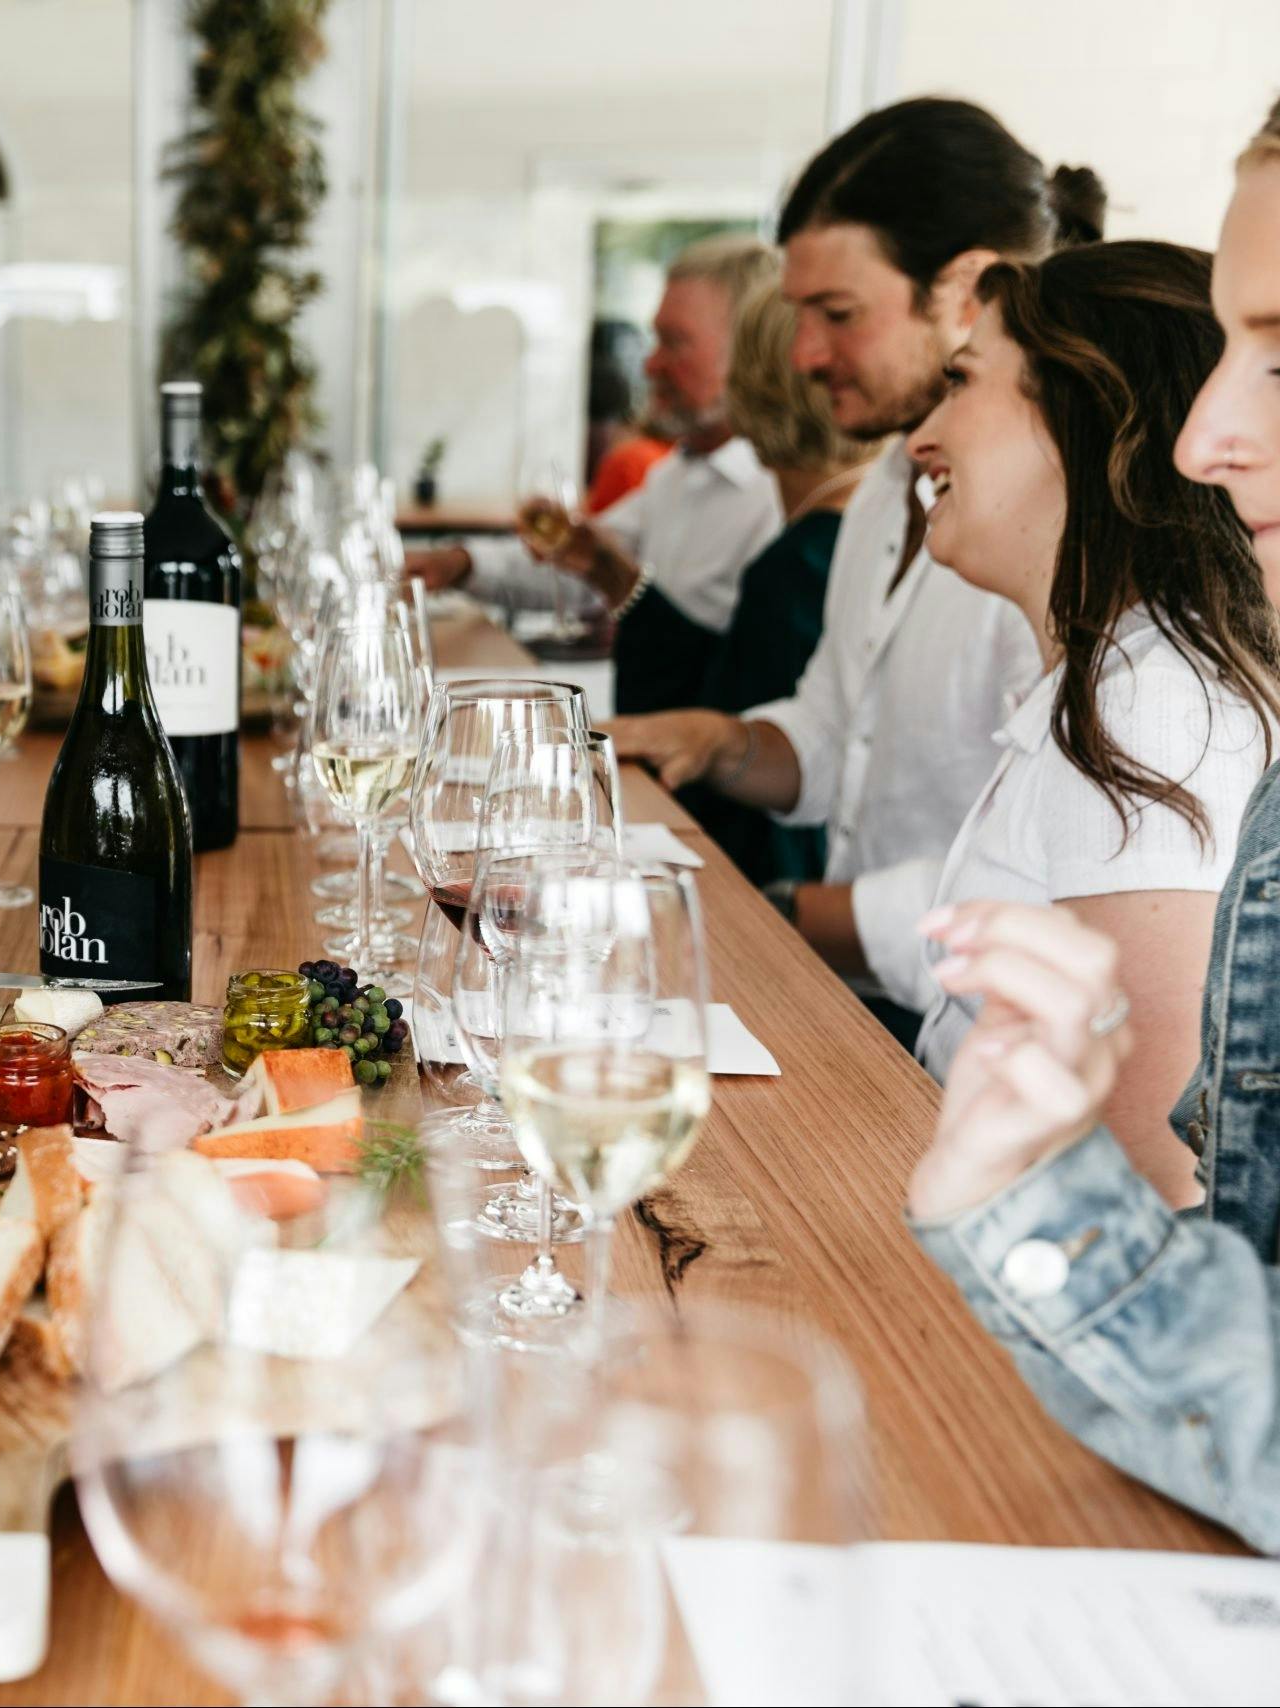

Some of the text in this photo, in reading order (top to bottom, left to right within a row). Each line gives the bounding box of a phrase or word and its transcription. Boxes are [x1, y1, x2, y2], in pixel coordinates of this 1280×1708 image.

[105, 579, 140, 603] rob
[153, 654, 207, 686] lan
[41, 896, 87, 937] rob
